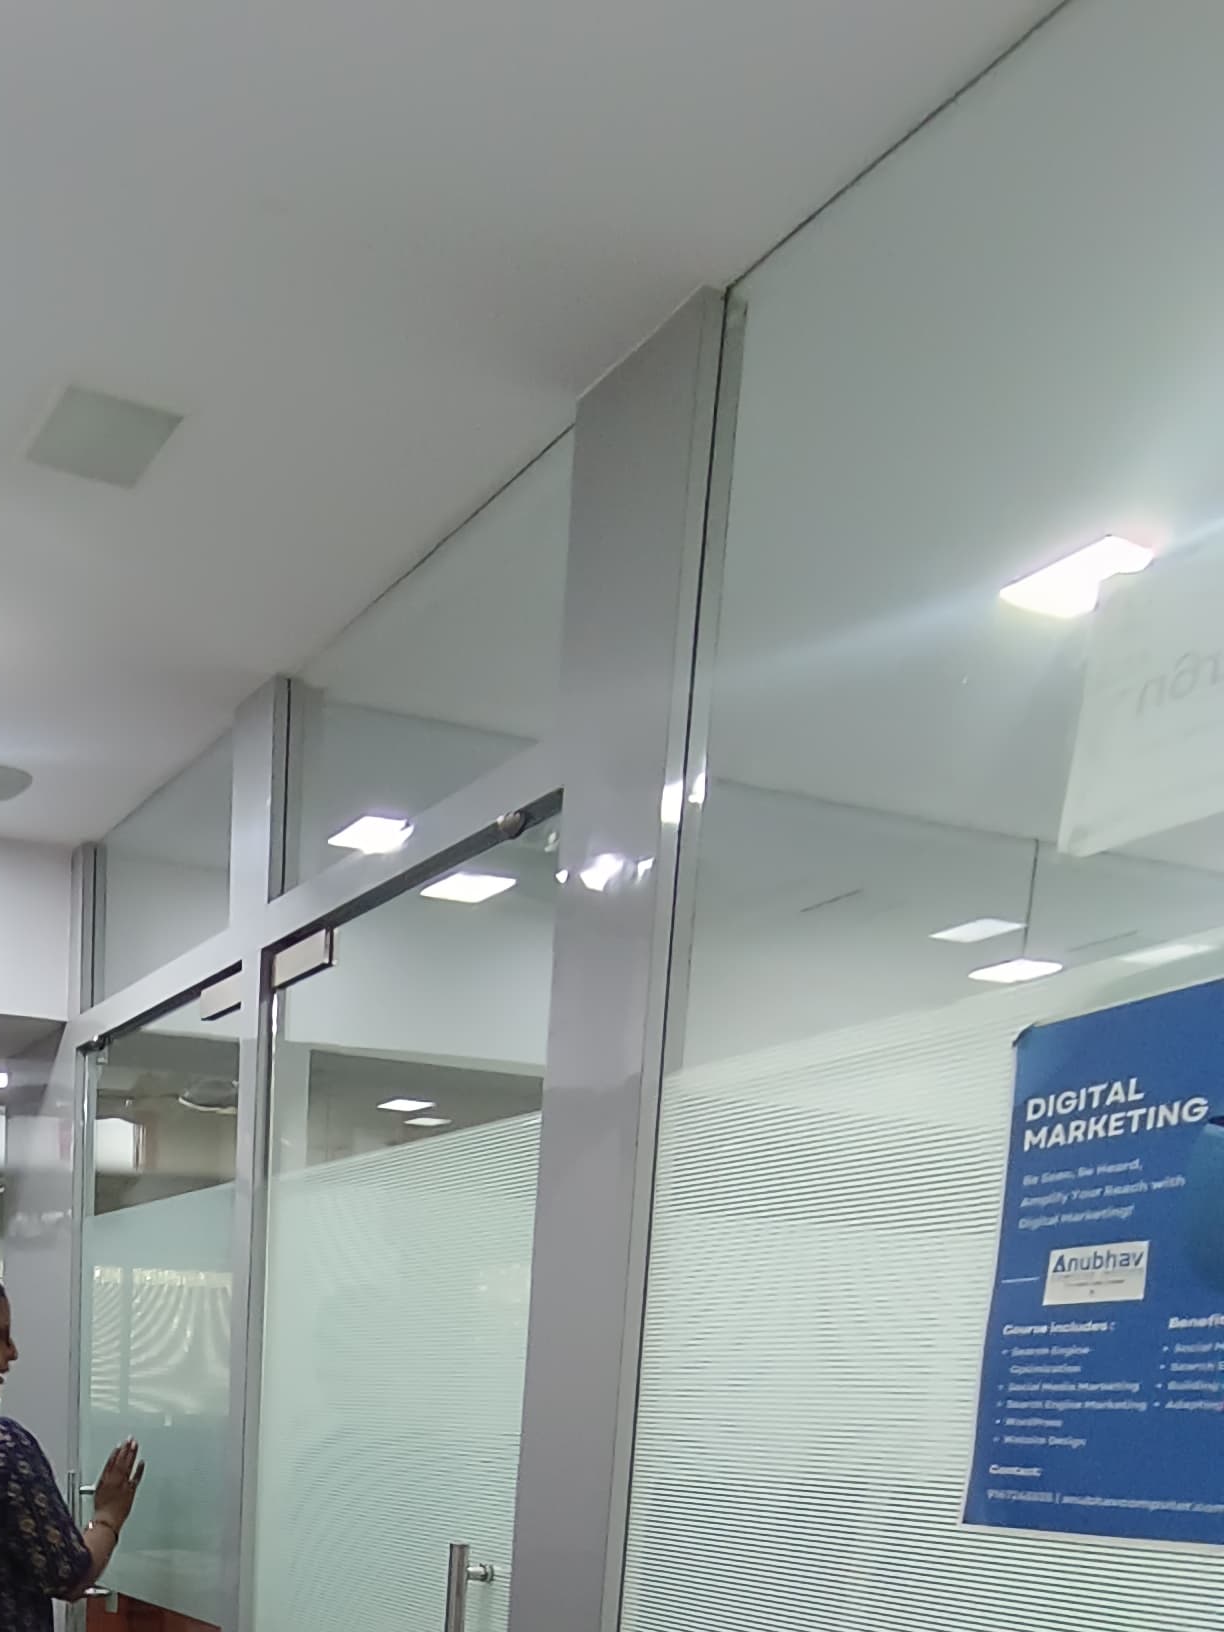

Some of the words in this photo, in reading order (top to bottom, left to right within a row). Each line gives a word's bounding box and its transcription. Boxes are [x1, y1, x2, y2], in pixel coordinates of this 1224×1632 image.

[1025, 1077, 1145, 1122] DIGITAL
[1023, 1096, 1210, 1152] MARKETING
[1052, 1250, 1145, 1273] Anubhav
